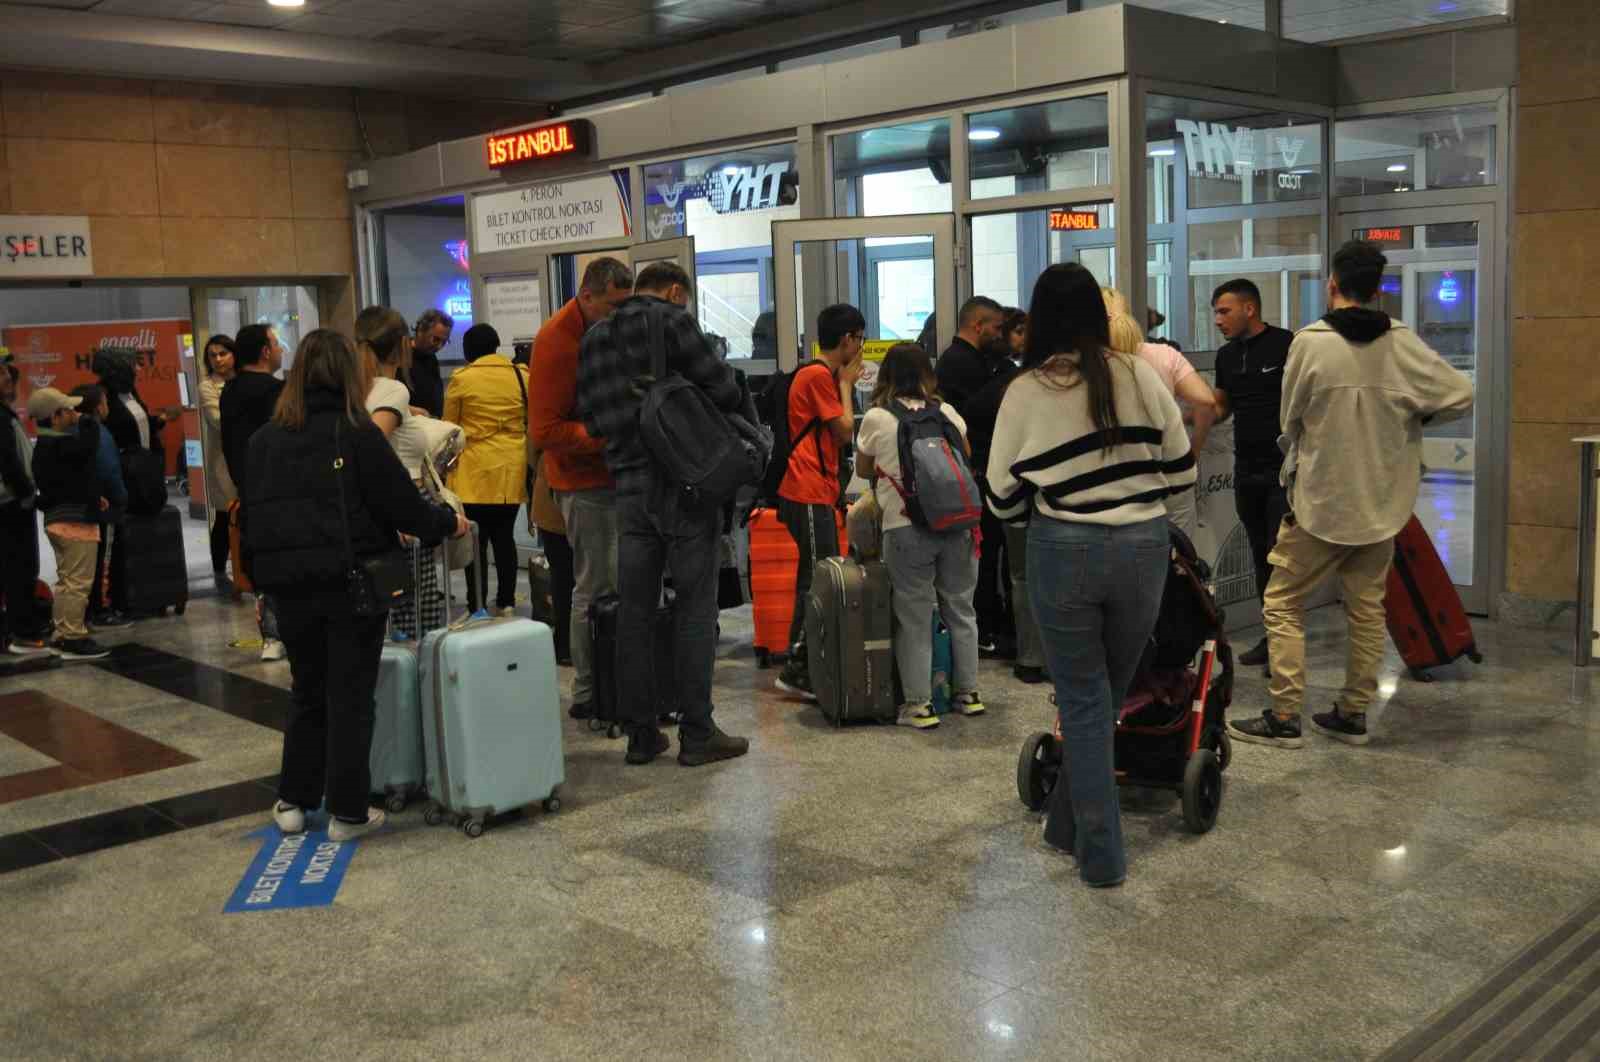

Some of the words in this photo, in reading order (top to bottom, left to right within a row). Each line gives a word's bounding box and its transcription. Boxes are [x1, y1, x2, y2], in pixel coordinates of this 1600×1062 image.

[488, 126, 574, 165] İSTANBUL
[530, 185, 563, 201] PERON
[719, 161, 790, 210] YHT
[487, 210, 510, 228] BİLET
[512, 207, 556, 225] KONTROL
[559, 201, 603, 220] NOKTASI
[496, 230, 527, 248] TICKET
[529, 225, 561, 244] CHECK
[564, 221, 595, 239] POINT
[0, 235, 87, 263] ŞELER
[1207, 473, 1233, 493] ESK
[300, 842, 341, 884] NOKTAS
